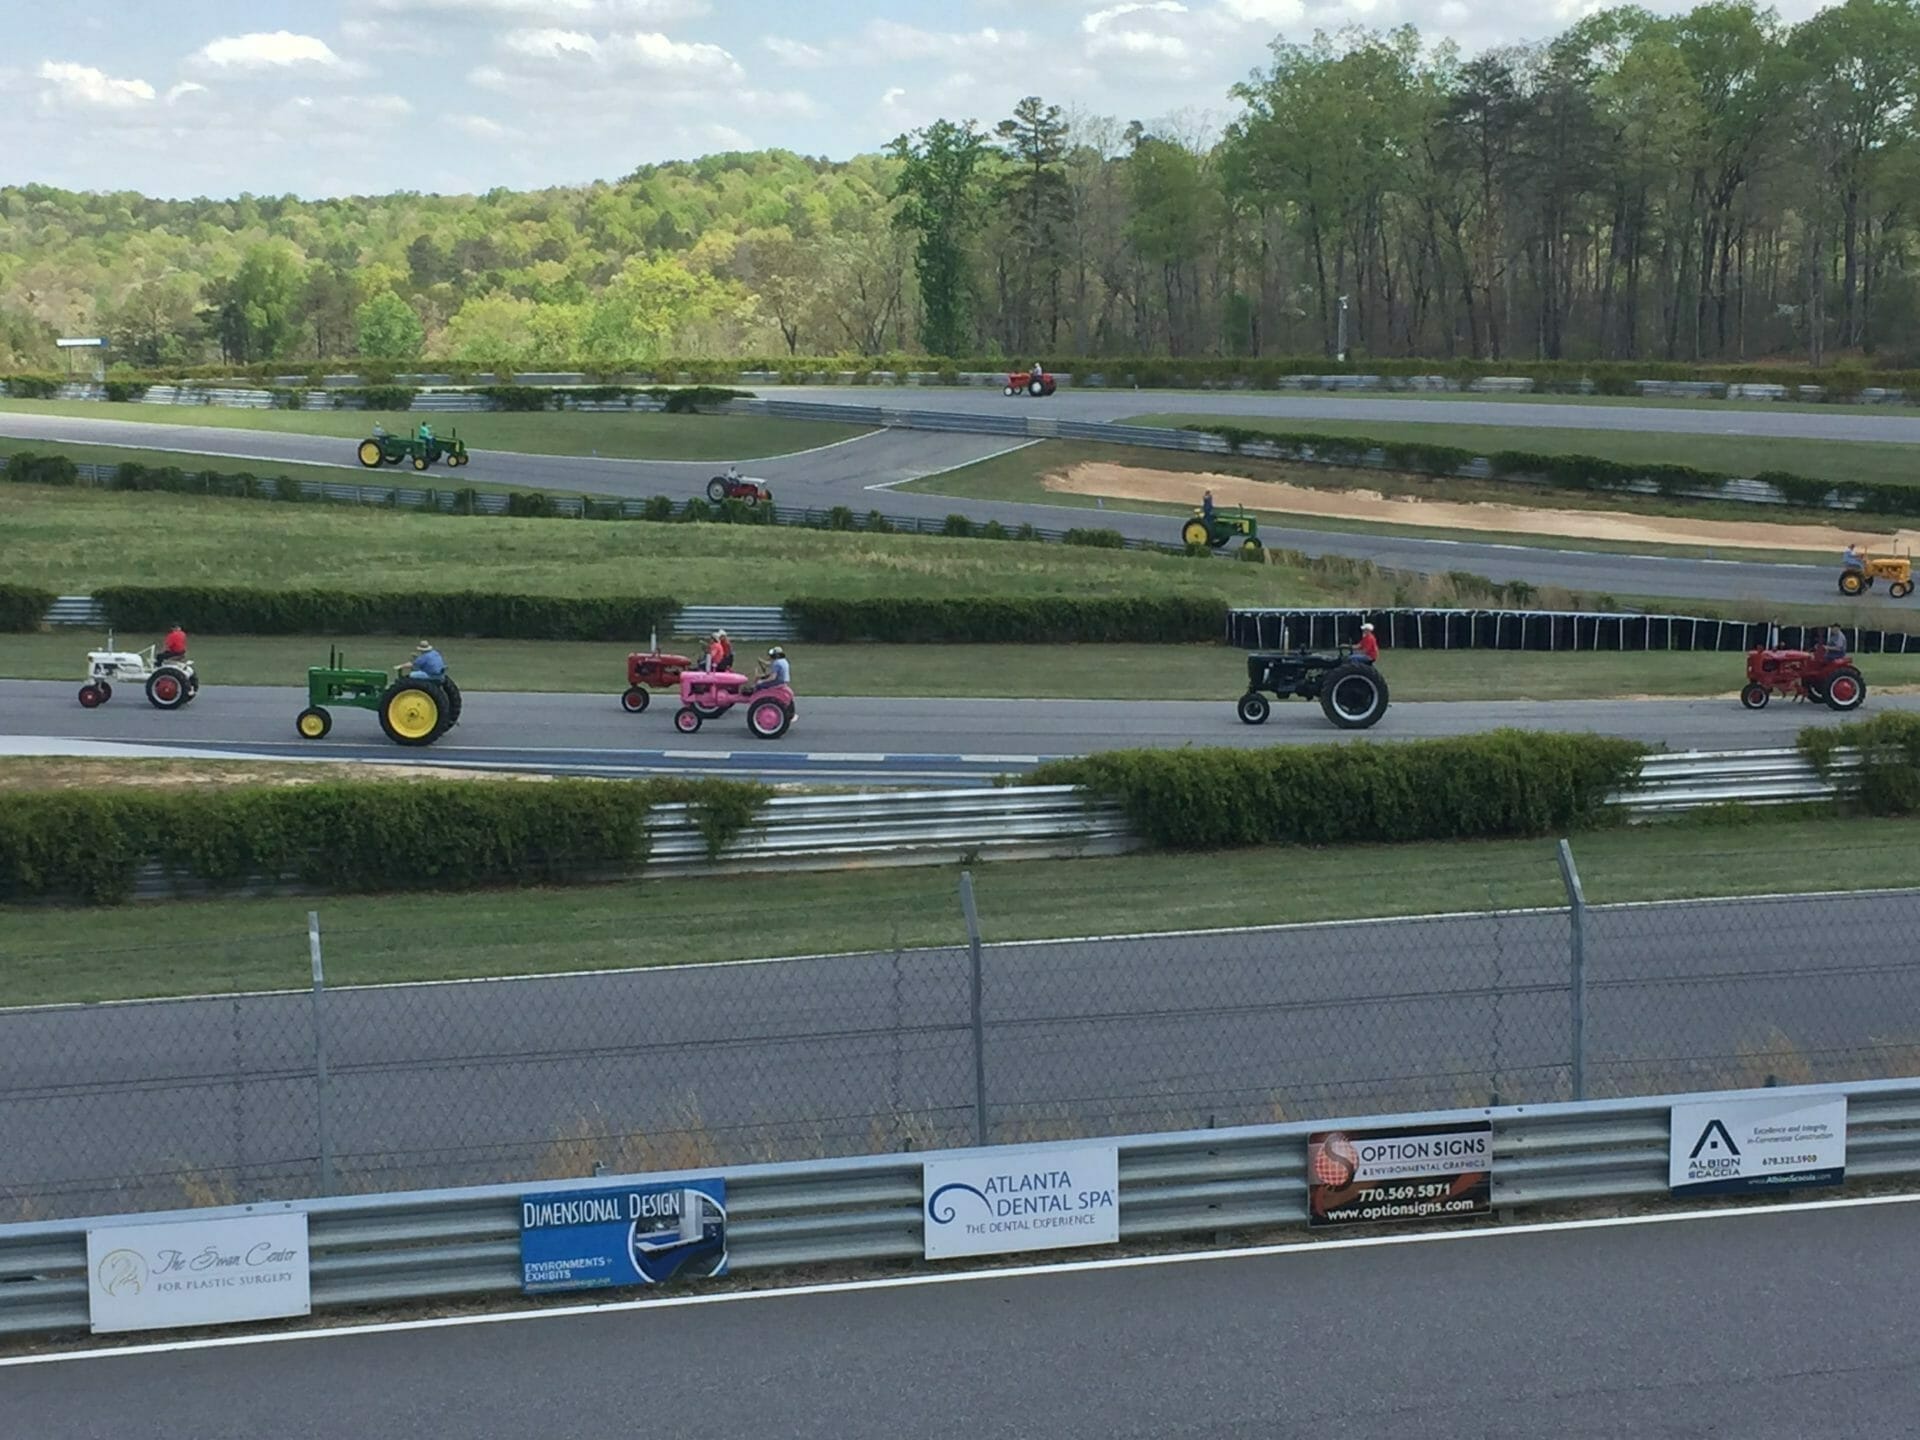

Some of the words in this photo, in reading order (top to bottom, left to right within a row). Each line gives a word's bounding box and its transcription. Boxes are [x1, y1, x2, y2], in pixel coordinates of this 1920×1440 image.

[1361, 1142, 1429, 1162] OPTION
[1433, 1138, 1485, 1157] SIGNS
[1369, 1163, 1440, 1177] ENVIRONMENTAL
[1443, 1160, 1486, 1172] GRAPHICS
[1688, 1158, 1741, 1170] ALBION
[1688, 1168, 1741, 1180] SCACCIA
[984, 1171, 1072, 1194] ATLANTA
[1358, 1183, 1450, 1202] 770.569.5871
[523, 1198, 621, 1229] DIMENSIONAL
[629, 1192, 680, 1219] DESIGN
[997, 1194, 1073, 1217] DENTAL
[1078, 1190, 1113, 1209] SPA
[1327, 1199, 1475, 1221] www.optionsigns.com
[966, 1224, 986, 1235] THE
[989, 1220, 1029, 1233] DENTAL
[1033, 1214, 1096, 1230] EXPERIENCE
[152, 1250, 186, 1275] The
[189, 1246, 240, 1271] Swan
[245, 1242, 297, 1267] Center
[525, 1257, 606, 1273] ENVIRONMENTS
[157, 1280, 183, 1292] FOR
[186, 1276, 235, 1290] PLASTIC
[240, 1272, 293, 1286] SURGERY
[525, 1270, 571, 1283] EXHIBITS
